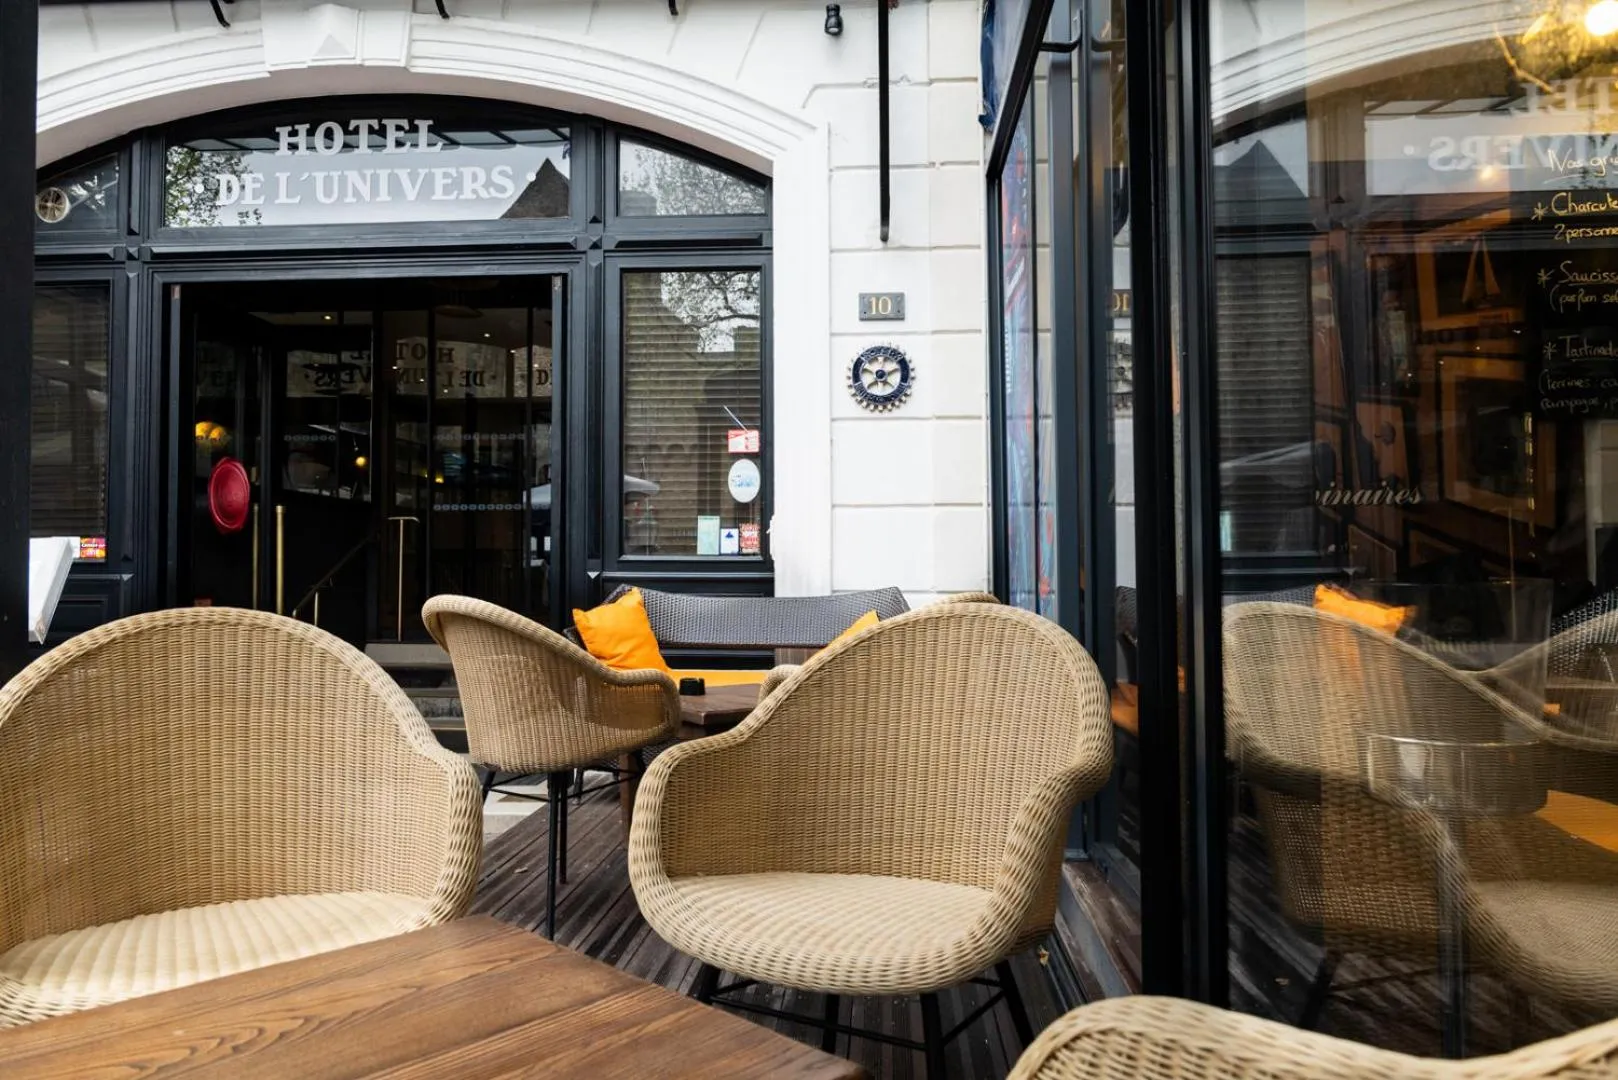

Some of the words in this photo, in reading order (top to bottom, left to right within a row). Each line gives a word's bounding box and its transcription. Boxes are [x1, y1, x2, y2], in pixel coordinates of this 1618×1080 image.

[275, 119, 444, 156] HOTEL
[216, 174, 264, 206] DE
[870, 296, 892, 314] 10
